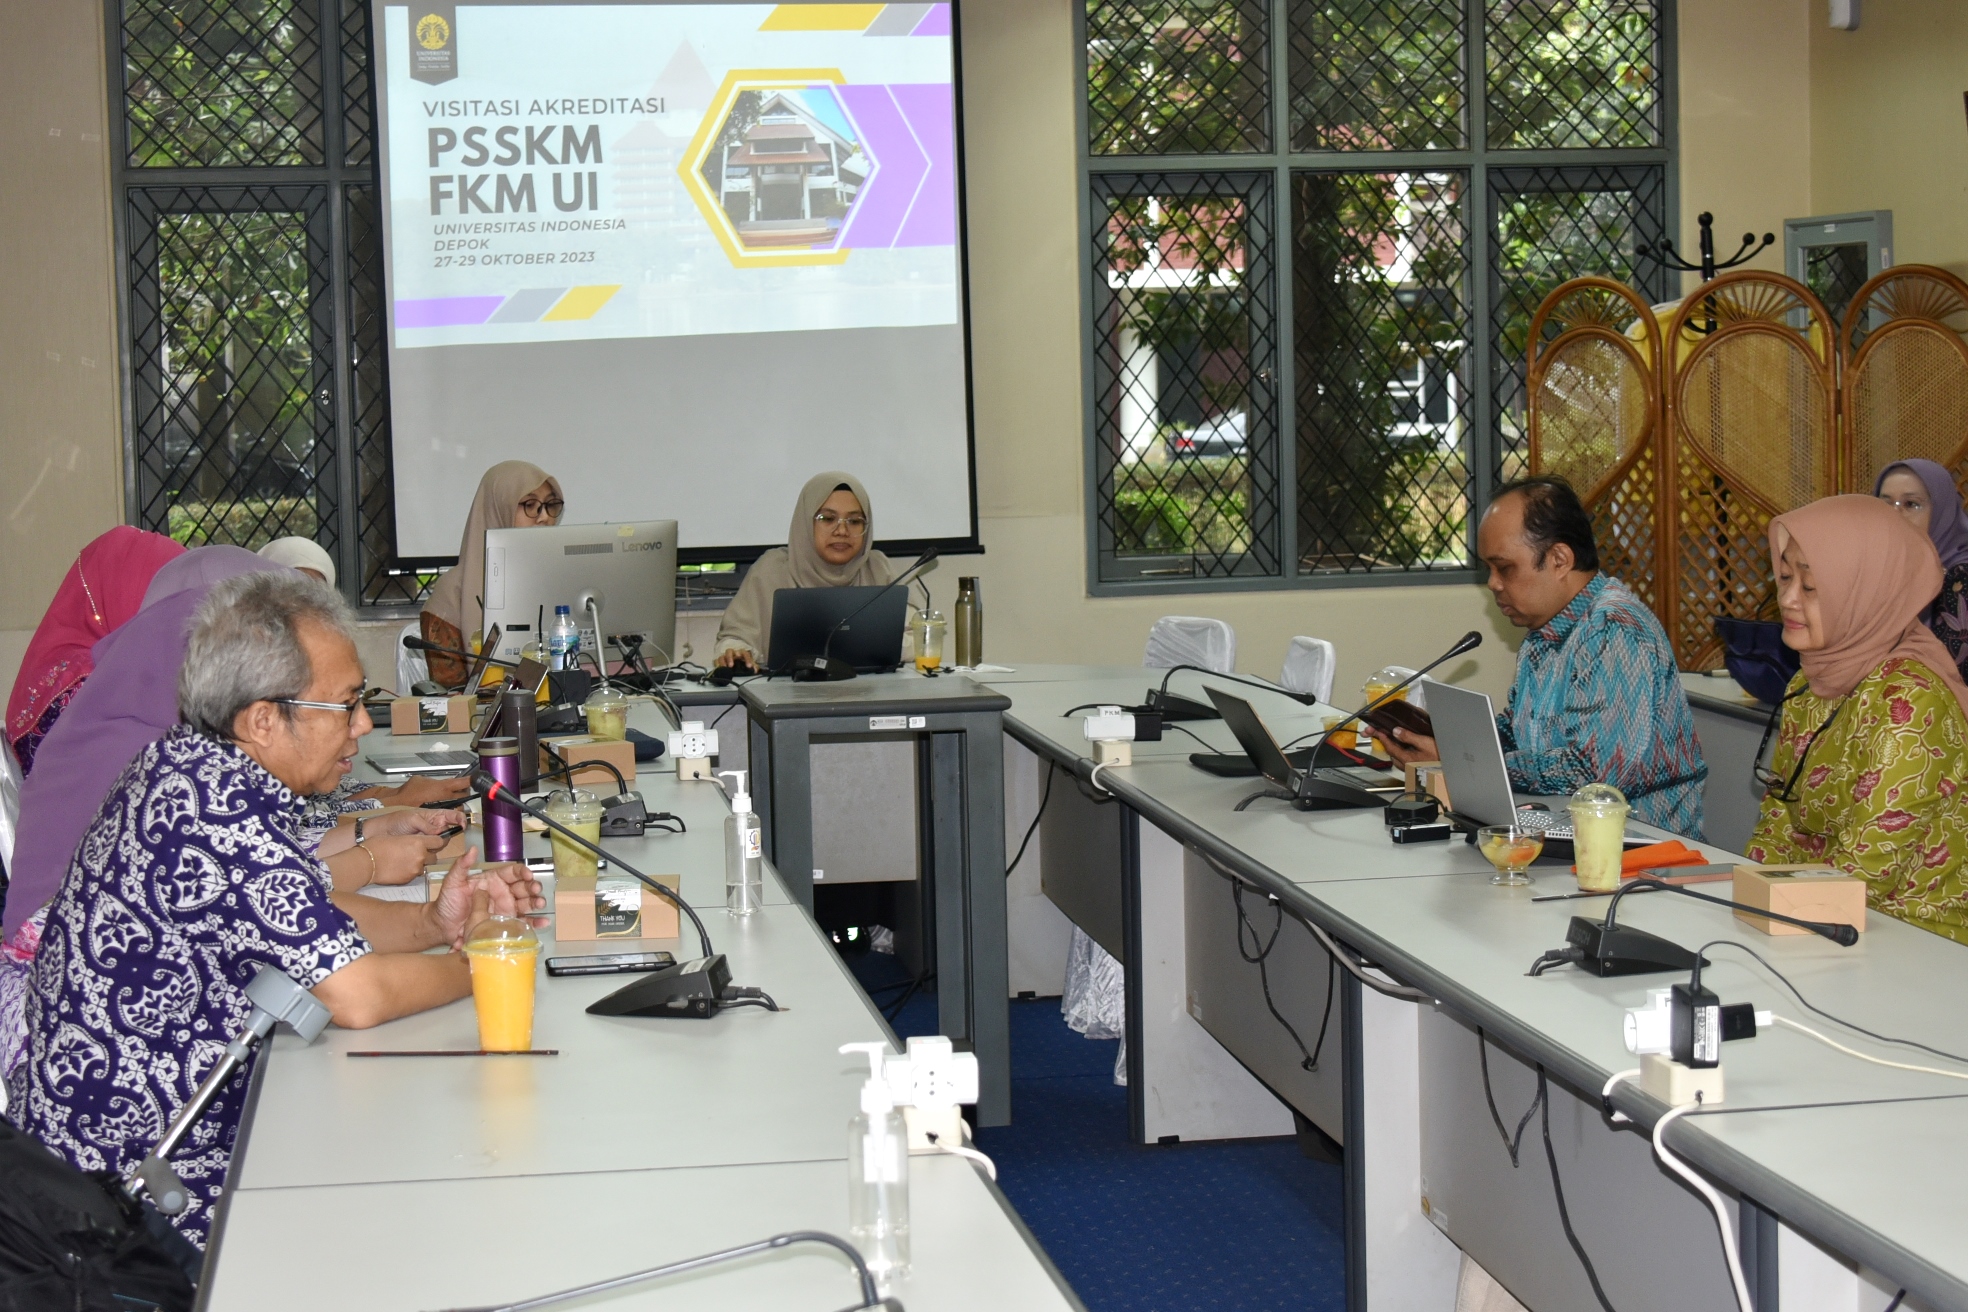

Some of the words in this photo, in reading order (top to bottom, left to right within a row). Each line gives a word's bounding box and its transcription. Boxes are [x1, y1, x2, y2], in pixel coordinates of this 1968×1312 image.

[423, 100, 520, 117] VISITASI
[528, 97, 665, 116] AKREDITASI
[428, 124, 603, 168] PSSKM
[429, 173, 537, 216] FKM
[552, 171, 599, 213] UI
[433, 221, 536, 236] UNIVERSITAS
[540, 219, 627, 233] INDONESIA
[433, 238, 490, 252] DEPOK
[433, 255, 476, 268] 27-29
[481, 252, 556, 266] OKTOBER
[559, 251, 595, 264] 2023
[621, 541, 662, 553] Lenovo
